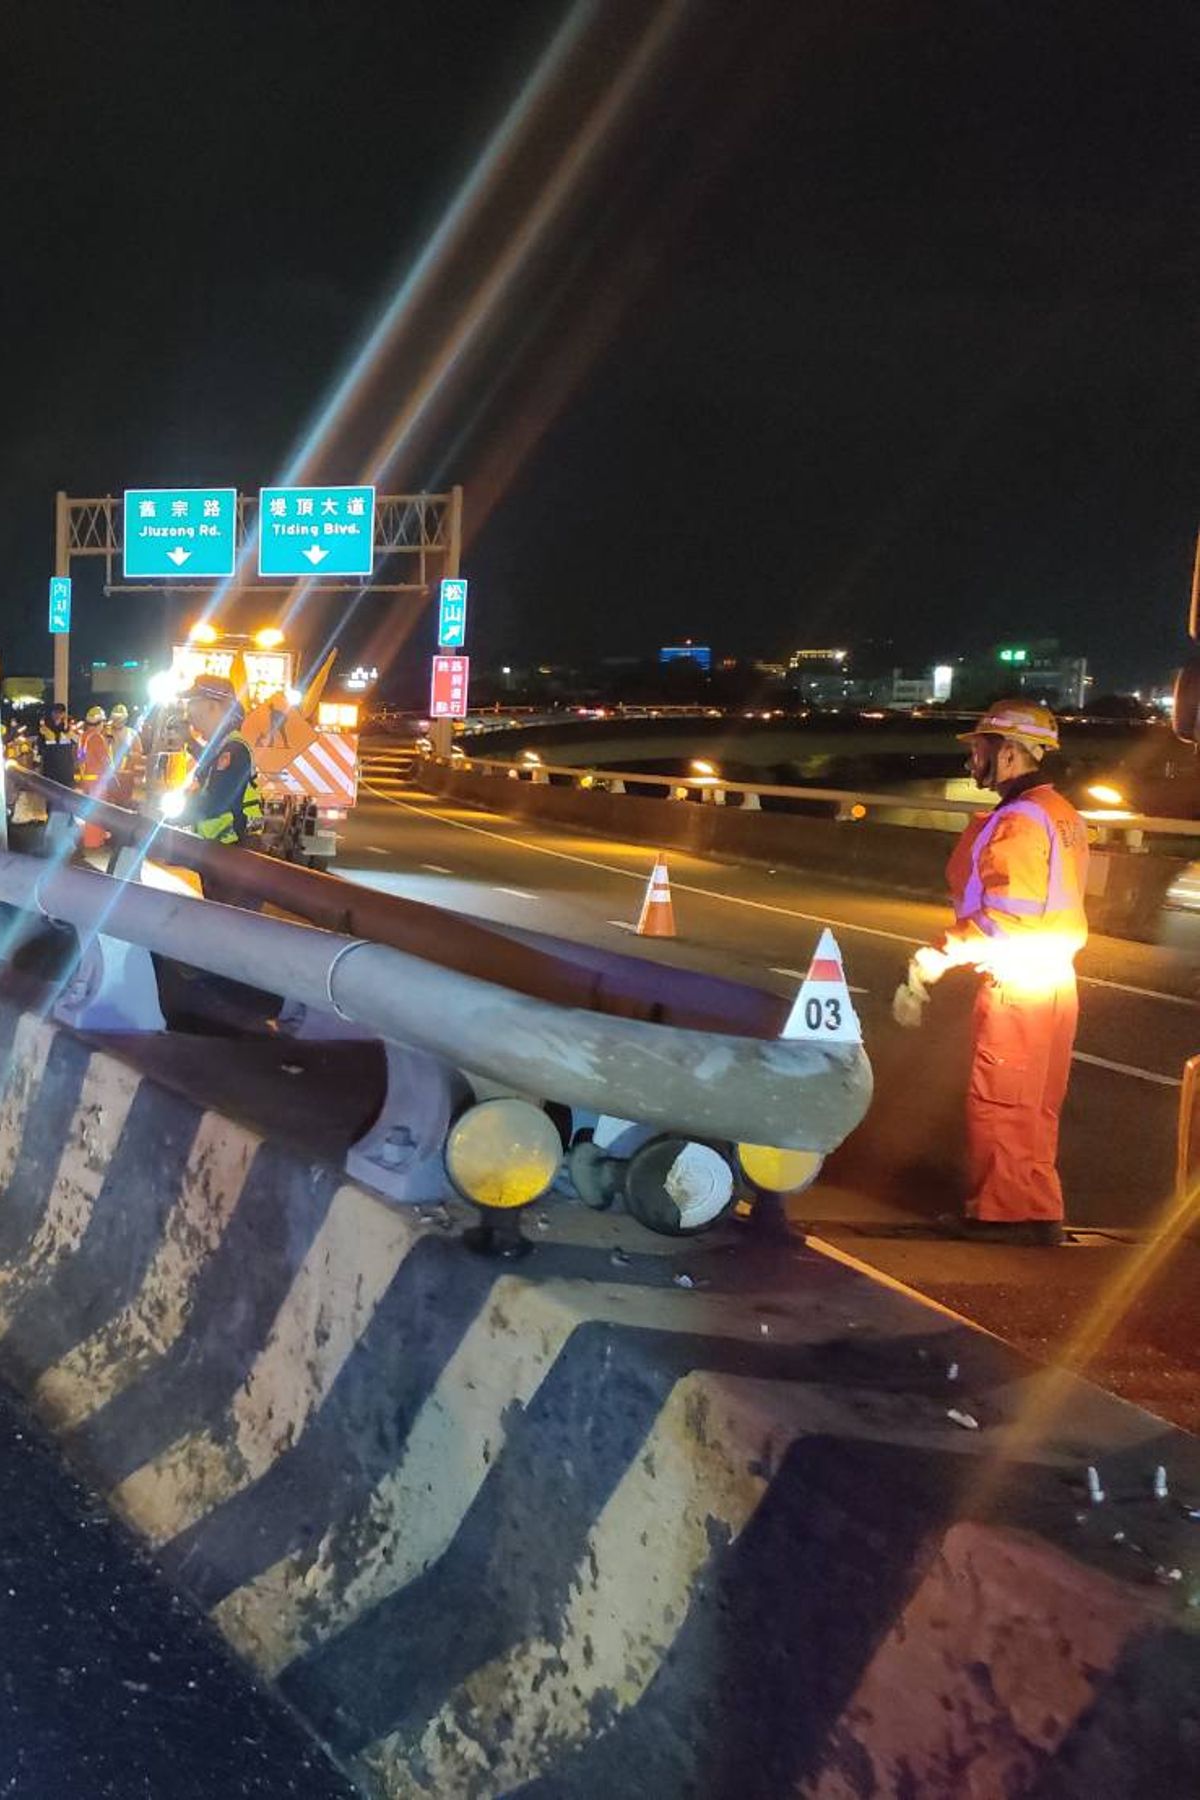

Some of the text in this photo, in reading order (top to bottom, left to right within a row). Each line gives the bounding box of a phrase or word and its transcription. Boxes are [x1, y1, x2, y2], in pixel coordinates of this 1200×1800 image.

[138, 499, 221, 518] 舊宗路
[269, 497, 366, 517] 堤頂大道
[138, 523, 221, 538] Jiuzong Rd.
[272, 522, 360, 537] Tiding Blvd.
[445, 584, 461, 622] 松山
[805, 998, 841, 1030] 03
